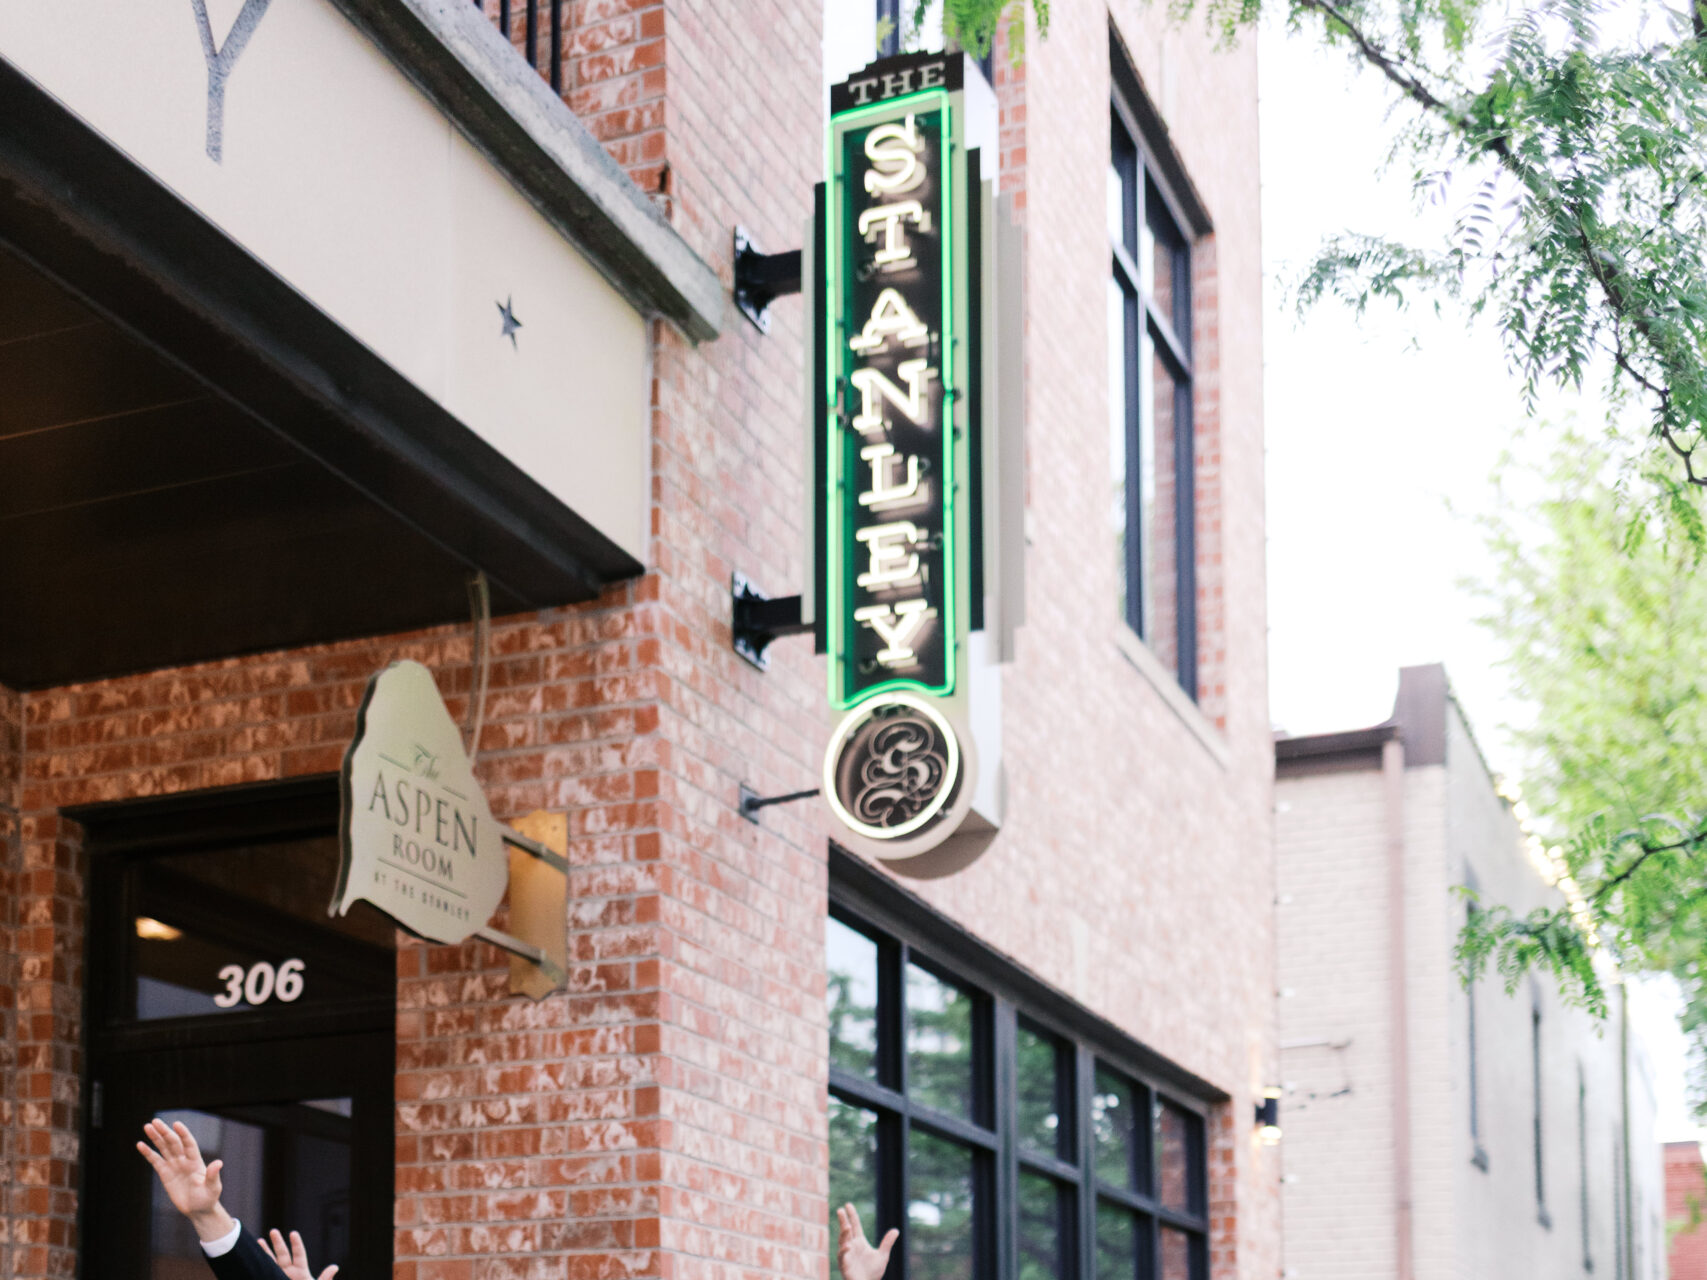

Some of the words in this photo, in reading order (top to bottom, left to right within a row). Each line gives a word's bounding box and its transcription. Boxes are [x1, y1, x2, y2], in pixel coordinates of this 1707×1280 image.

[848, 61, 945, 106] THE
[849, 112, 936, 668] STANLEY
[368, 769, 477, 857] ASPEN
[392, 833, 454, 881] ROOM
[213, 958, 306, 1008] 306
